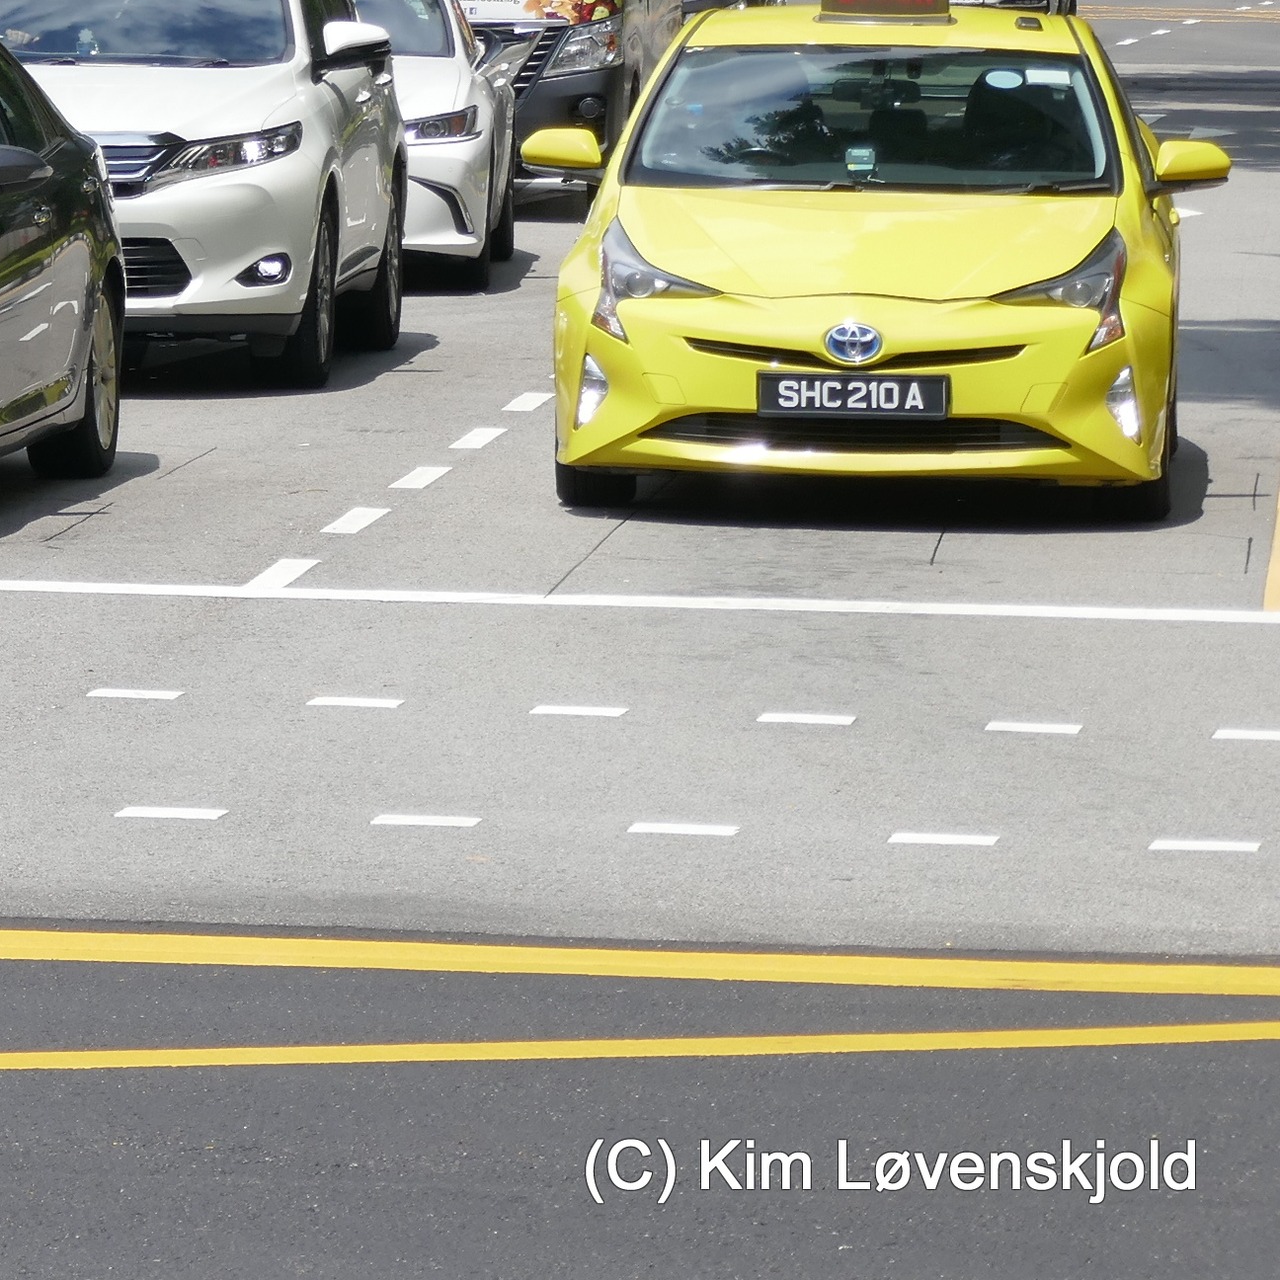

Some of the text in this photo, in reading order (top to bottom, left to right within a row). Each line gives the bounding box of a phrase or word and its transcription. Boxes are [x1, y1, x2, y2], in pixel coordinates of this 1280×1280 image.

[778, 380, 925, 410] SHC 210 A
